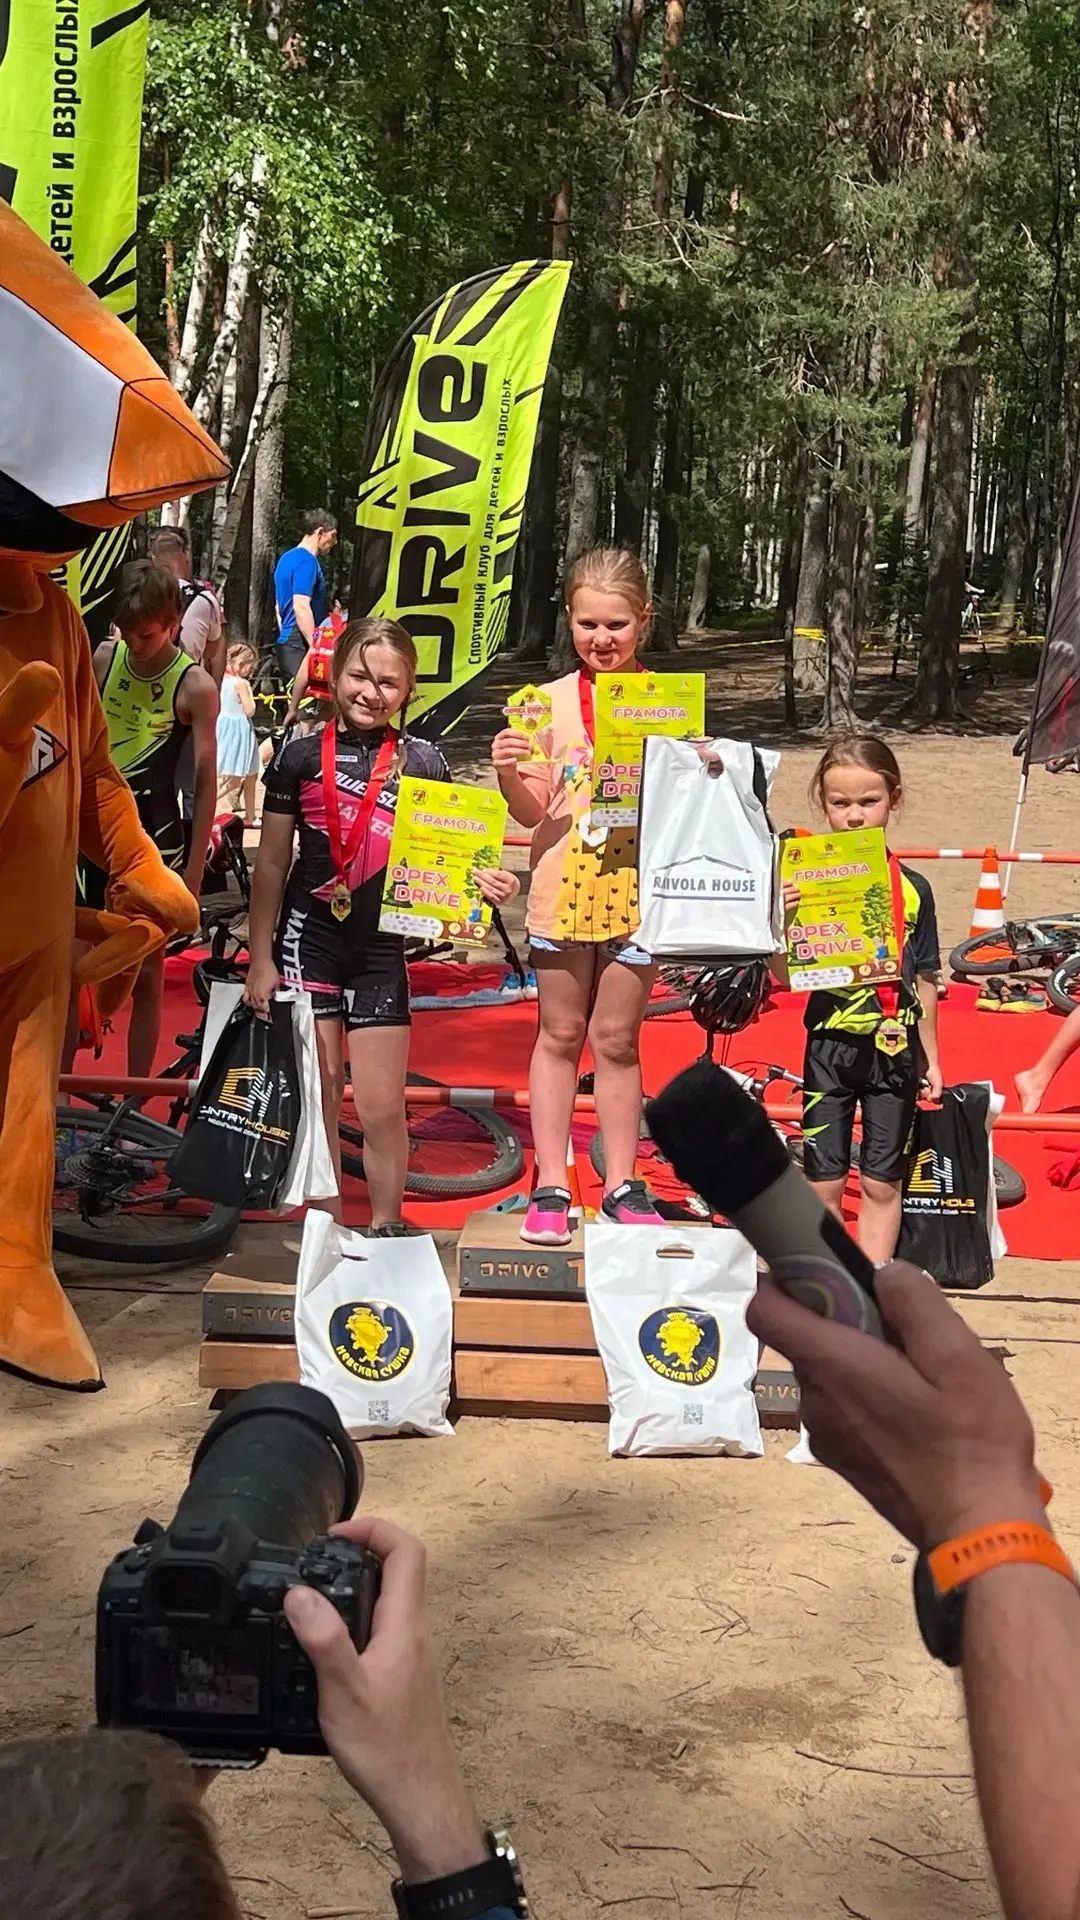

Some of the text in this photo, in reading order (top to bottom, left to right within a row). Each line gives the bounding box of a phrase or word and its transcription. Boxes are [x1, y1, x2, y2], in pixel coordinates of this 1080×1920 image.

[468, 378, 512, 665] Спортивный клуб для детей и взрослых
[613, 707, 689, 720] ГРАМОТА
[604, 782, 640, 797] DRI
[413, 812, 487, 833] ГРАМОТА
[436, 856, 445, 866] 2
[795, 863, 871, 882] ГРАМОТА
[712, 879, 756, 892] HOUSE
[395, 885, 461, 908] DRIVE
[828, 907, 837, 916] 3
[797, 938, 864, 959] DRIVE
